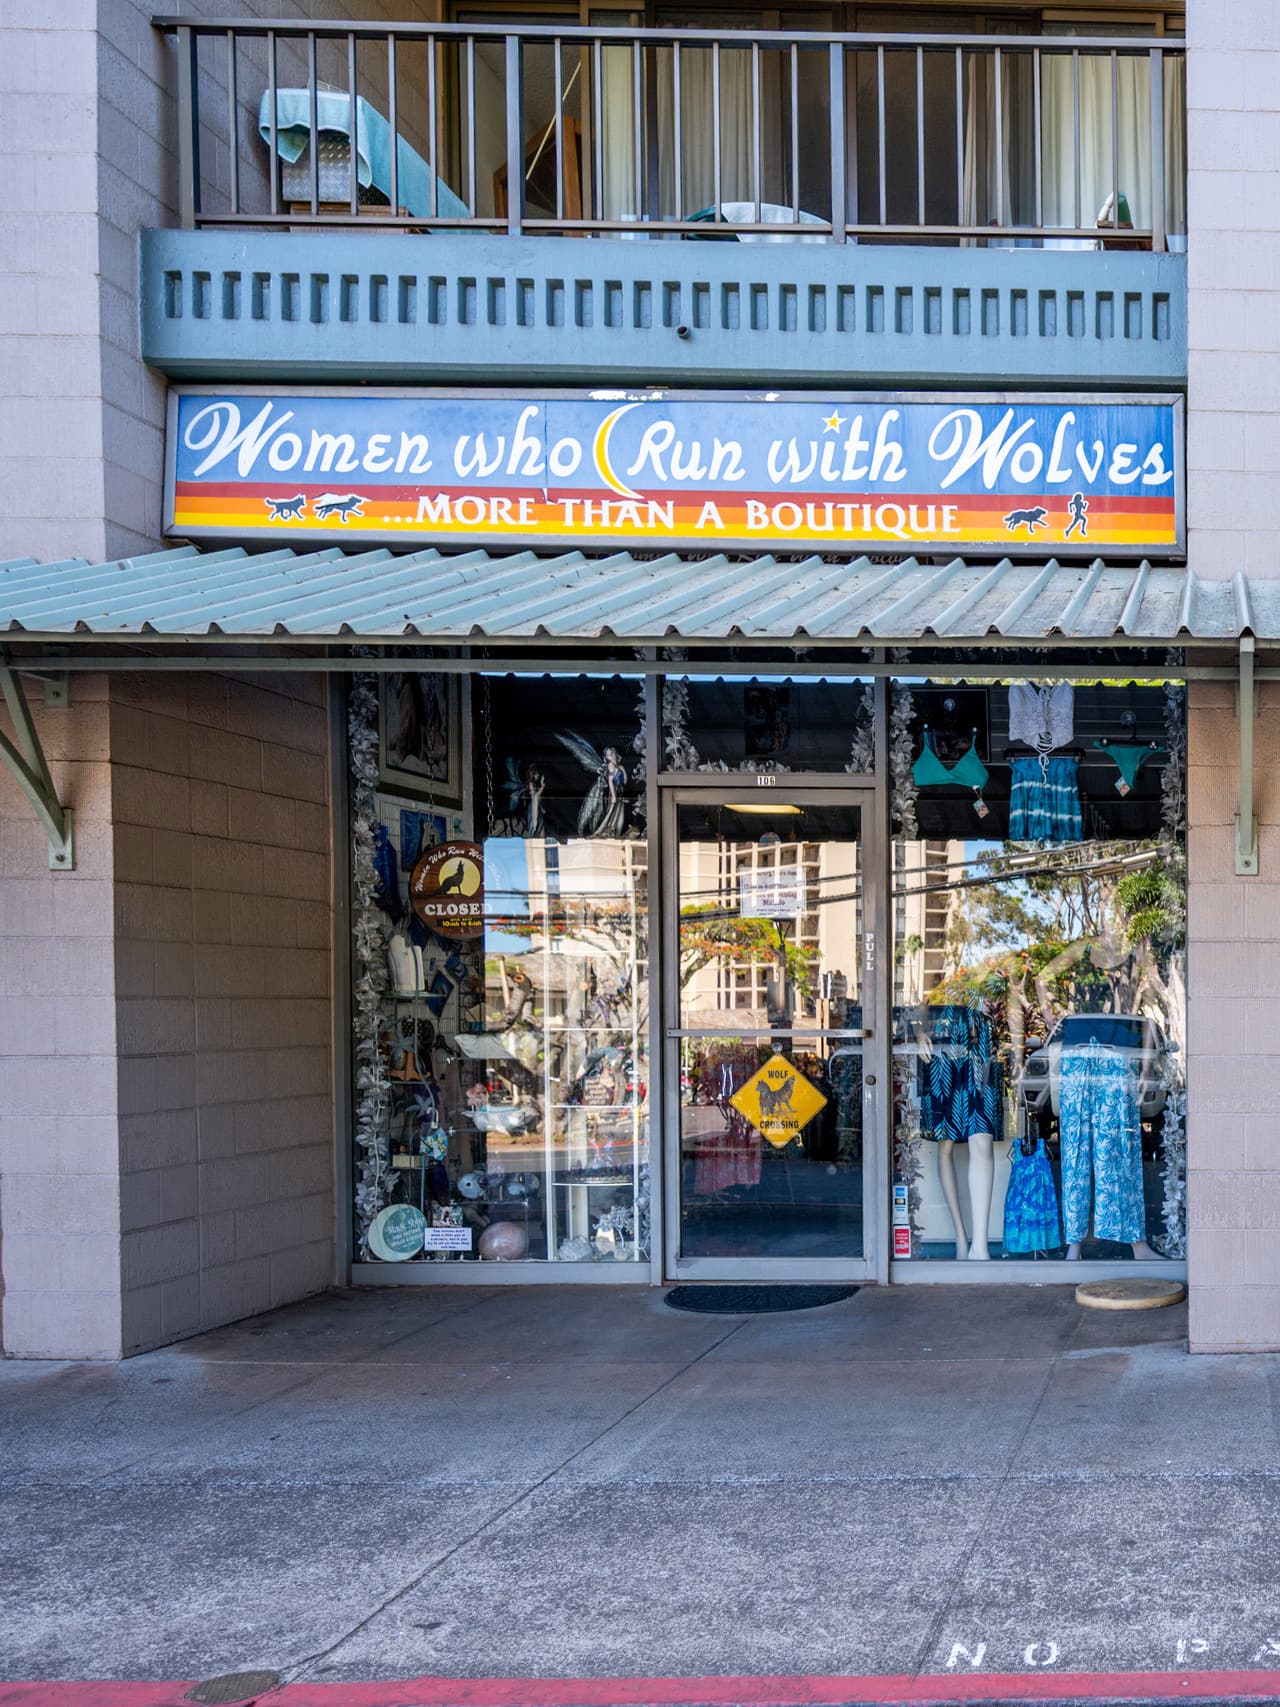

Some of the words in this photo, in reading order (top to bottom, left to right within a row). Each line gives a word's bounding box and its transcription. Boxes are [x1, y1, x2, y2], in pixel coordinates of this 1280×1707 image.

[183, 401, 432, 477] Women
[454, 405, 582, 478] who
[627, 420, 745, 482] Run
[767, 409, 907, 483] with
[928, 408, 1174, 490] Wolves
[557, 498, 675, 529] THAN
[696, 501, 726, 530] A
[746, 500, 960, 538] BOUTIQUE
[758, 776, 775, 785] 106
[865, 933, 874, 970] PULL
[768, 1070, 789, 1079] WOLF
[759, 1120, 799, 1129] CROSSING
[946, 1641, 1060, 1668] NO
